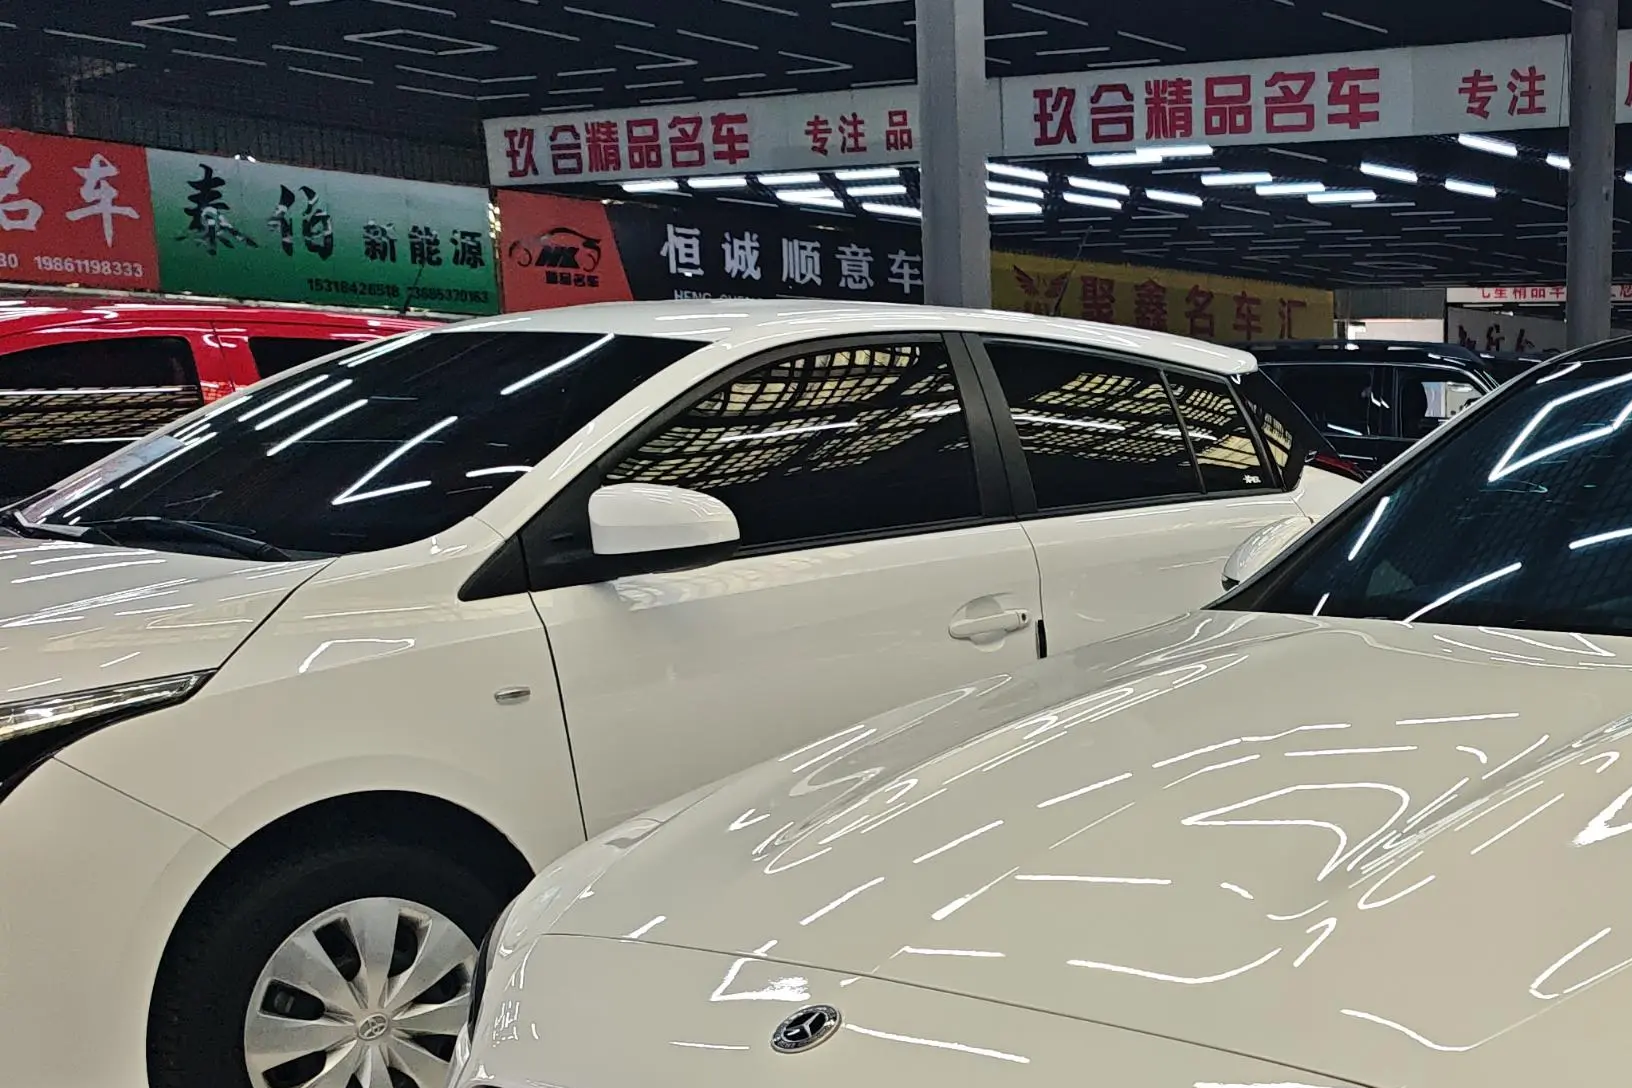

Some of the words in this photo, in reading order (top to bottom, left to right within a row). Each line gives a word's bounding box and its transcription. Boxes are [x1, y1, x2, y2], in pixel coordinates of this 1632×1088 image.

[1032, 67, 1381, 147] 玖合精品名车
[1458, 66, 1547, 119] 专注
[504, 112, 750, 178] 玖合精品名车
[804, 112, 868, 156] 专注
[34, 256, 143, 277] 19861198333
[363, 220, 486, 269] 新能源
[660, 224, 923, 293] 恒诚顺意车
